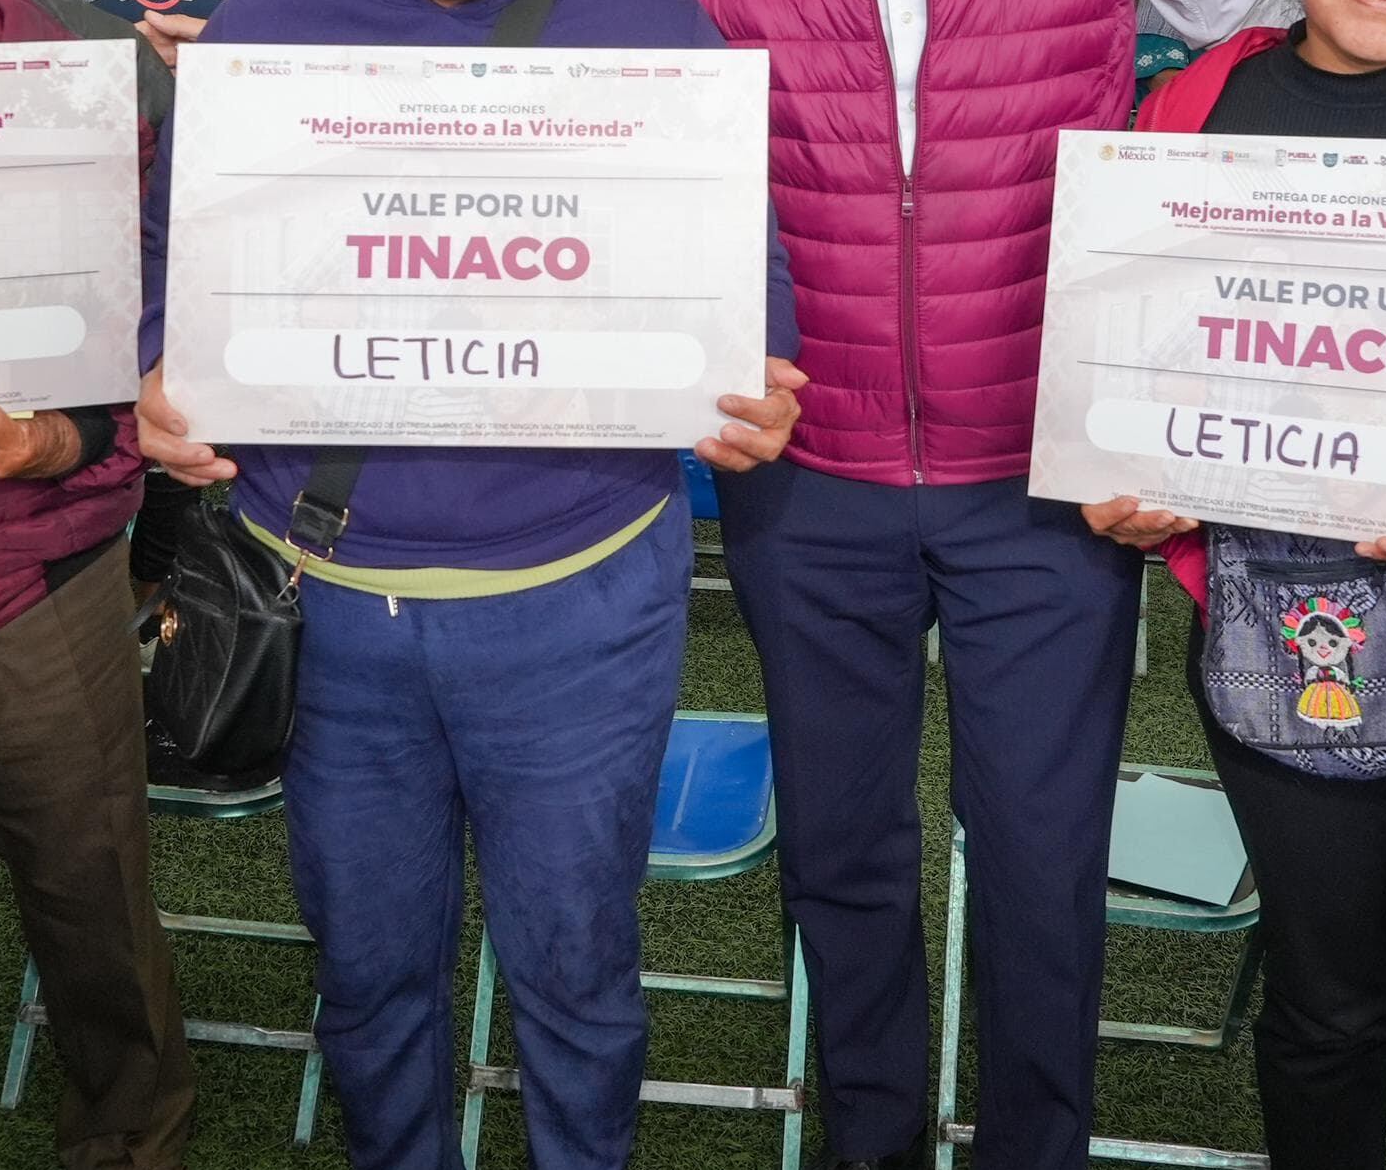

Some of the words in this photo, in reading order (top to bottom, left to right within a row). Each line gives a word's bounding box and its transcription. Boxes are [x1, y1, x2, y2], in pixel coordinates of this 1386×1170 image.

[248, 64, 291, 76] México
[400, 104, 457, 113] ENTREGA
[461, 105, 476, 113] DE
[480, 105, 545, 114] ACCIONES
[301, 116, 477, 138] “Mejoramiento
[483, 124, 495, 135] a
[503, 119, 522, 136] la
[529, 118, 643, 136] Vivienda”
[1117, 149, 1156, 161] México
[1167, 148, 1209, 158] Bienestar
[1287, 151, 1317, 159] PUEBLA
[363, 193, 446, 216] VALE
[456, 194, 523, 217] POR
[533, 195, 578, 217] UN
[1253, 191, 1308, 202] ENTREGA
[1312, 194, 1327, 203] DE
[1162, 201, 1326, 225] “Mejoramiento
[1332, 214, 1344, 226] a
[1352, 210, 1371, 227] la
[346, 235, 590, 281] TINACO
[1216, 276, 1294, 304] VALE
[1302, 282, 1369, 309] POR
[335, 335, 537, 379] LETICIA
[1167, 409, 1358, 473] LETICIA
